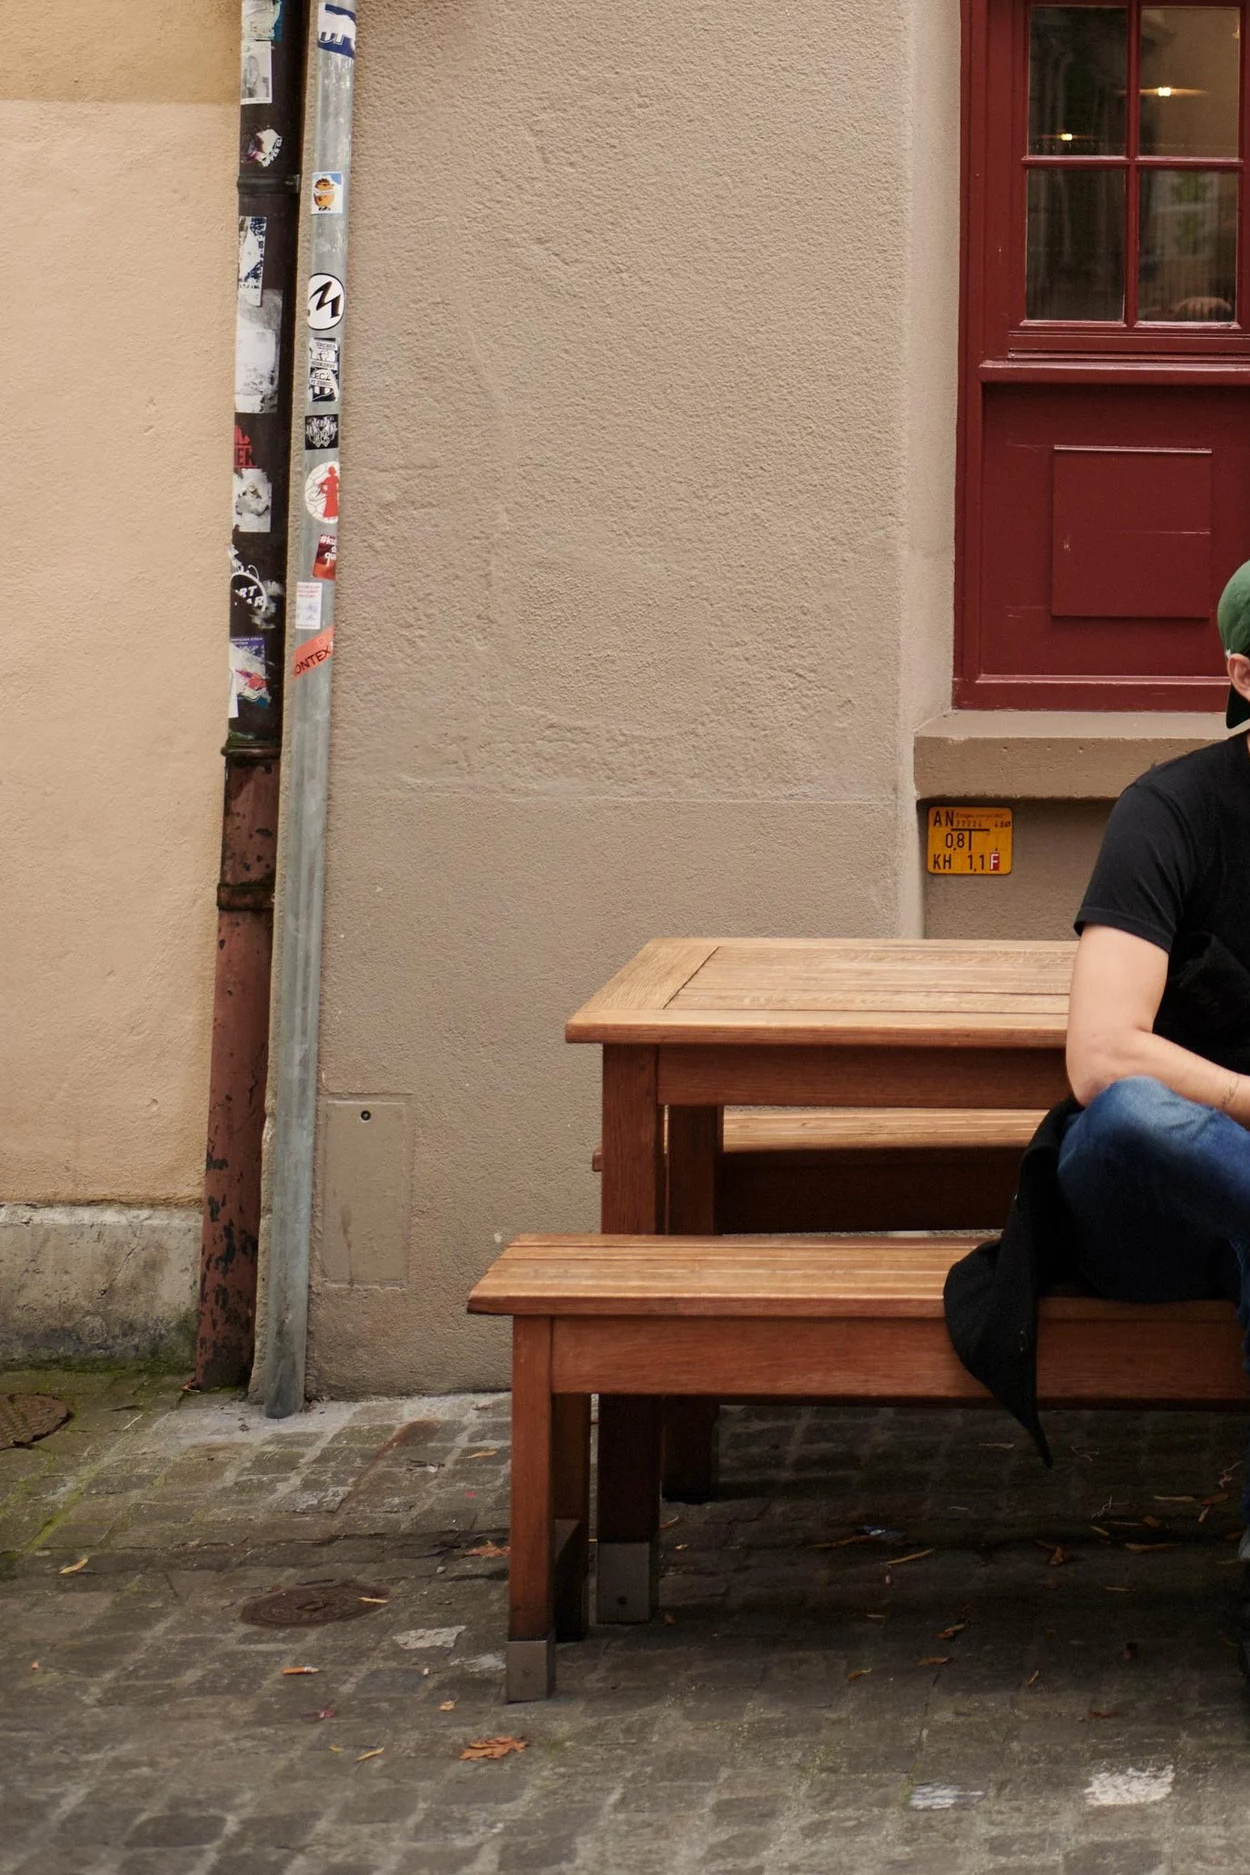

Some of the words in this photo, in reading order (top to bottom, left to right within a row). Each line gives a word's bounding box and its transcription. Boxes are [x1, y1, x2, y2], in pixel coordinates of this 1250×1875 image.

[934, 812, 953, 827] AN
[933, 854, 952, 870] KH
[990, 853, 999, 871] F
